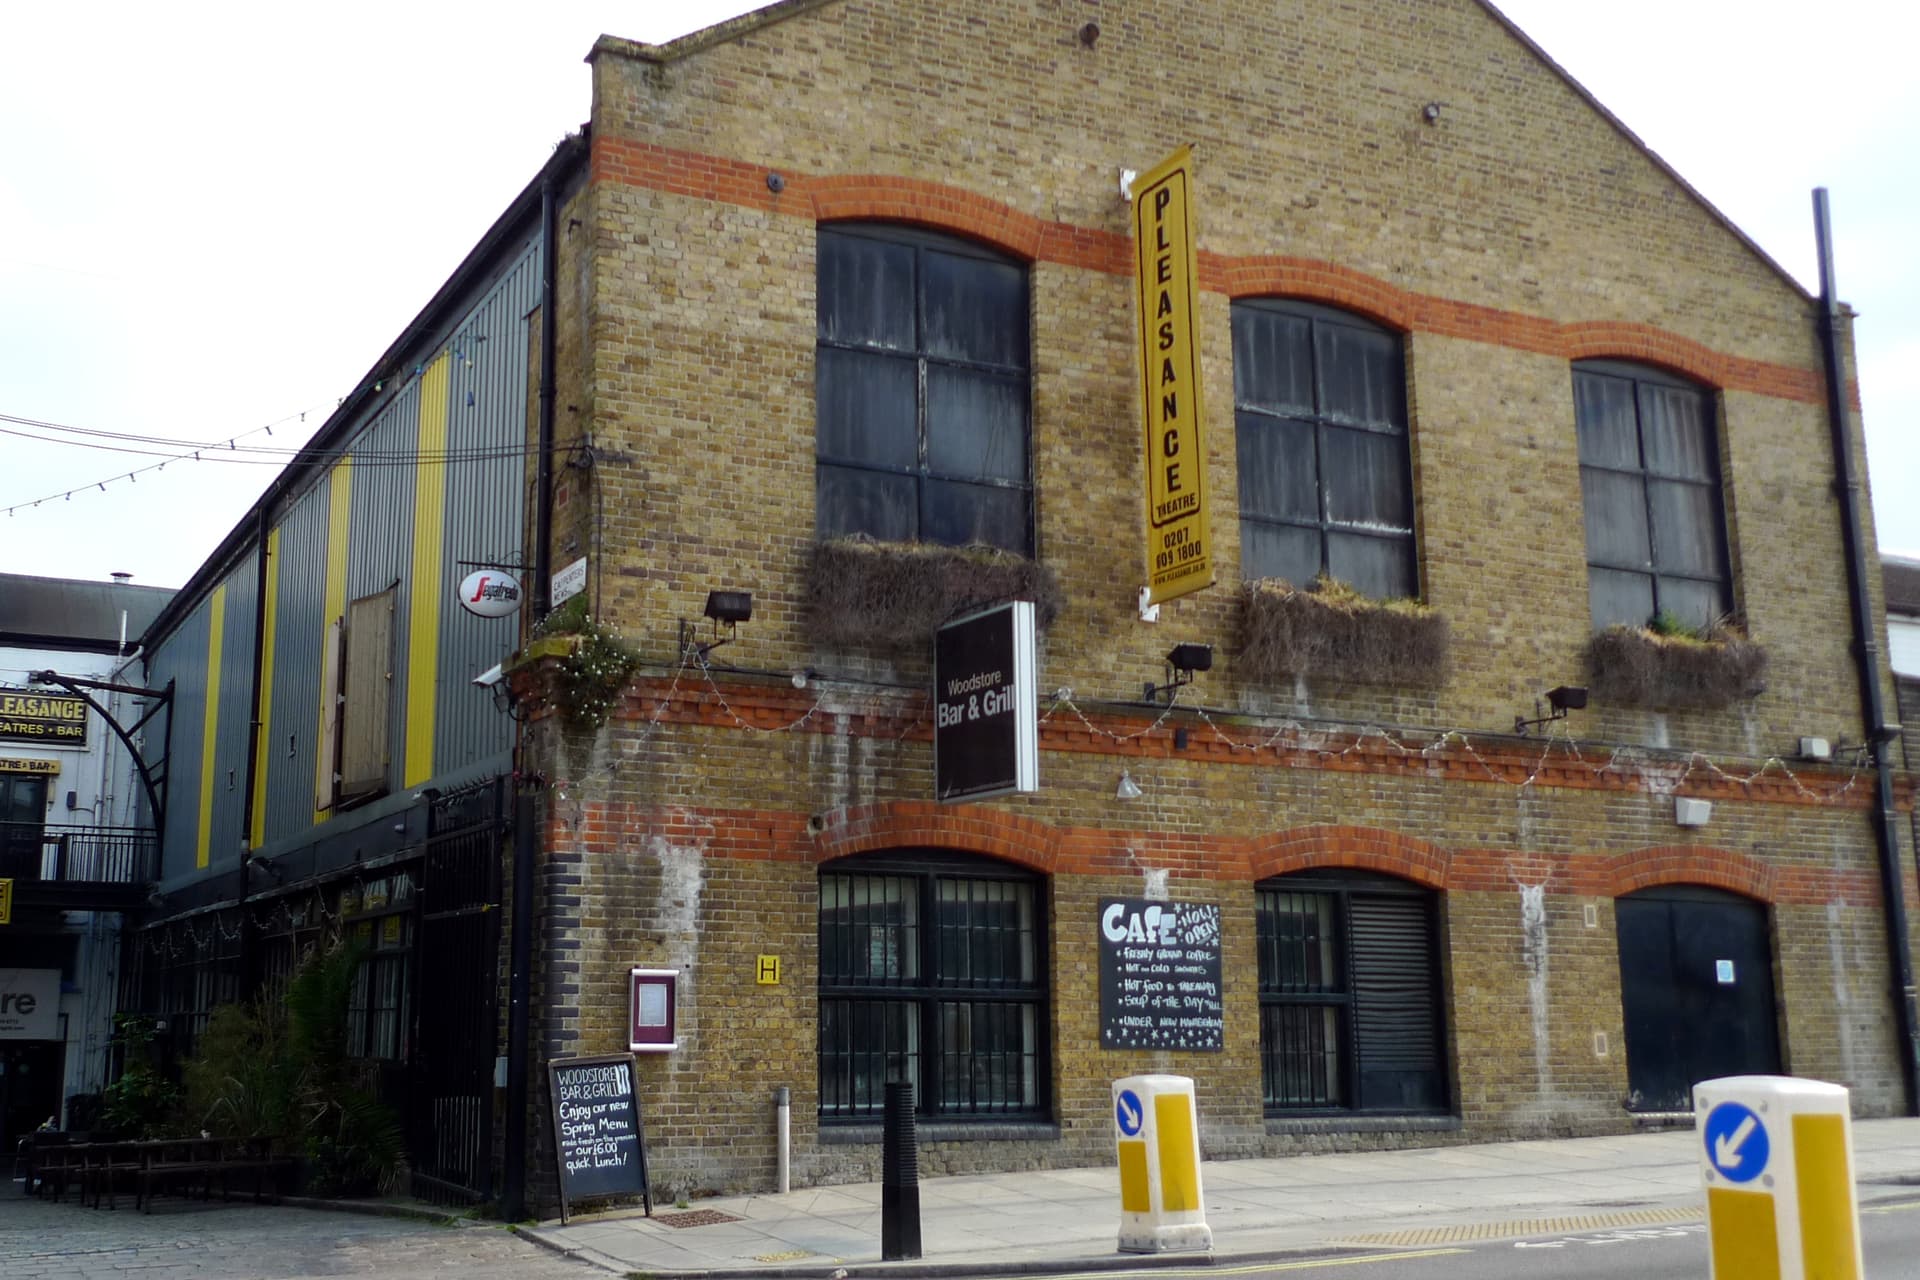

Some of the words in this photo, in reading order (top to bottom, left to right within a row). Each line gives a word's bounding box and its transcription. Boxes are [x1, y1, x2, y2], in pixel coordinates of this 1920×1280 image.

[1154, 186, 1182, 494] PLEASANCE
[1156, 493, 1196, 519] THEATRE
[1164, 527, 1189, 549] 0207
[1156, 549, 1174, 570] 609
[1177, 540, 1202, 562] 1800
[470, 576, 519, 602] Segafredo
[947, 670, 1002, 697] Woodstore
[938, 702, 965, 729] Bar
[968, 694, 980, 720] &
[983, 683, 1016, 717] Grill
[57, 725, 83, 737] BAR
[29, 760, 50, 771] BAR
[1102, 903, 1177, 945] CAFE
[1181, 904, 1213, 927] NOW
[1185, 918, 1219, 945] OPEN
[760, 958, 777, 981] H
[1151, 963, 1170, 973] COLD
[1124, 978, 1142, 992] HOT
[1124, 994, 1149, 1009] SOUP
[1184, 995, 1205, 1014] DAY
[1124, 1015, 1154, 1028] UNDER
[557, 1066, 618, 1086] WOODSTORE
[560, 1085, 583, 1101] BAR
[583, 1084, 593, 1100] &
[592, 1082, 621, 1097] GRILL
[560, 1101, 592, 1121] Enjoy
[592, 1103, 608, 1114] our
[609, 1101, 629, 1112] new
[561, 1121, 596, 1139] Spring
[599, 1117, 629, 1131] Menu
[575, 1147, 593, 1156] our
[566, 1156, 592, 1176] quick
